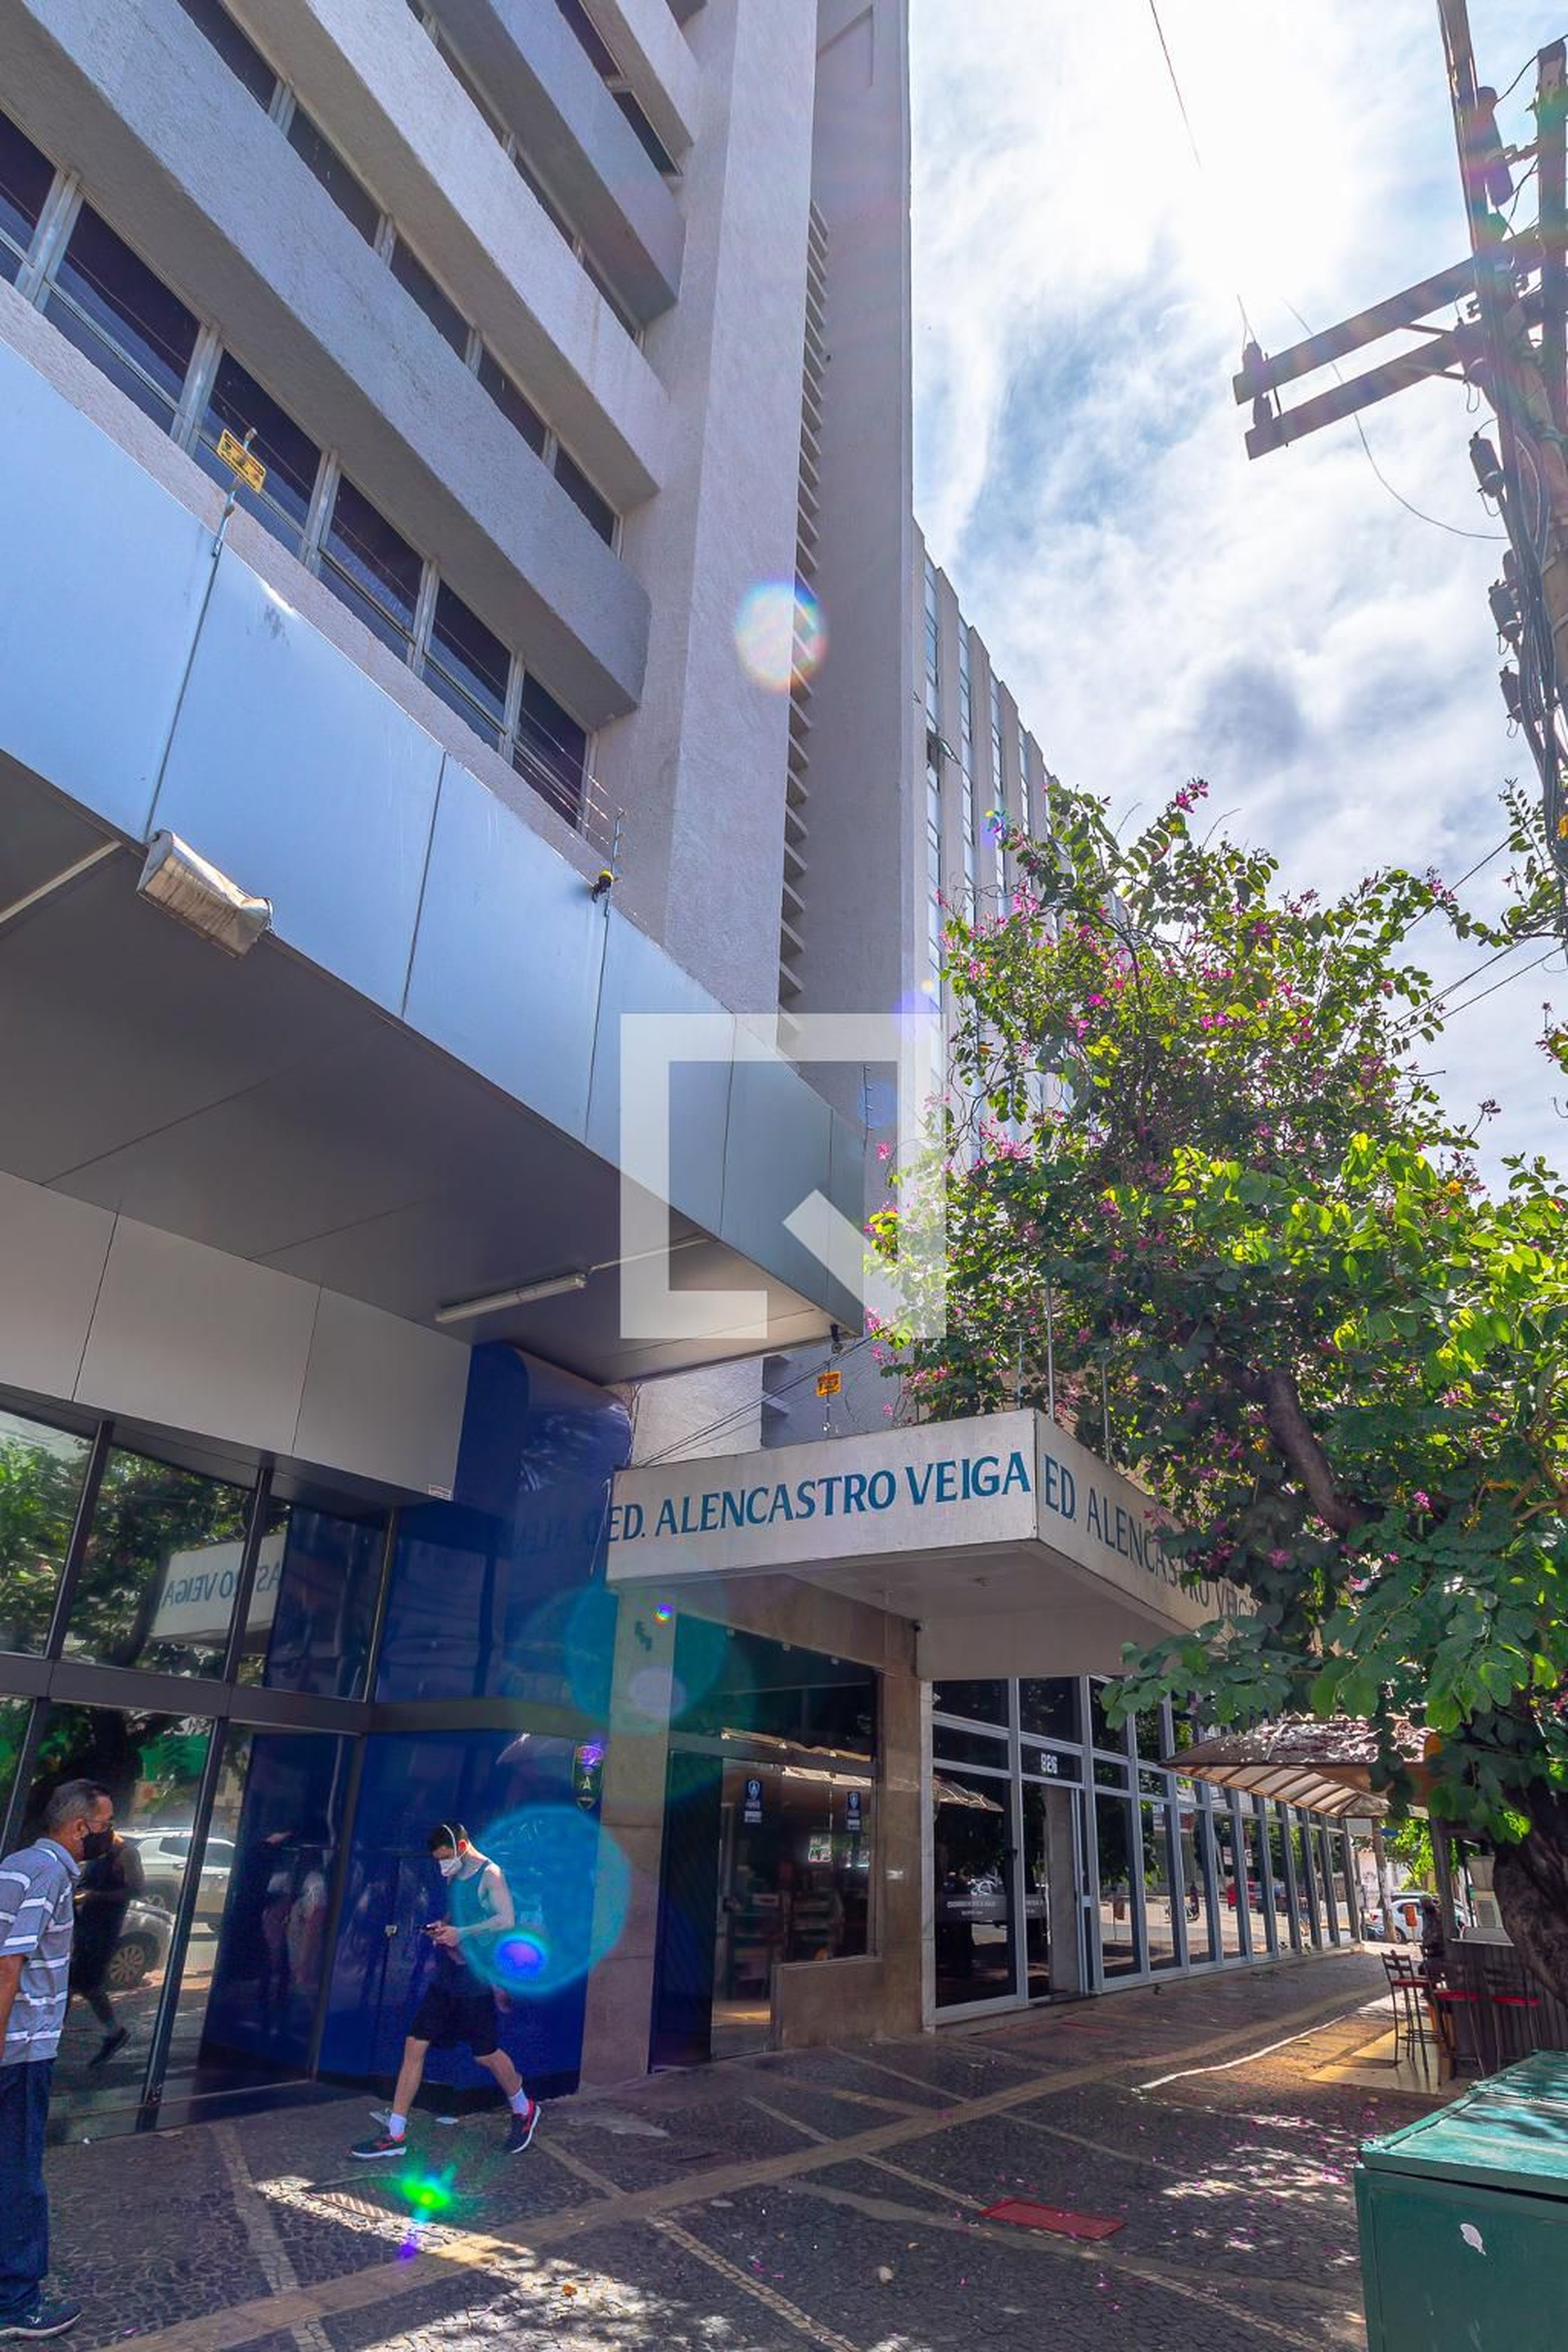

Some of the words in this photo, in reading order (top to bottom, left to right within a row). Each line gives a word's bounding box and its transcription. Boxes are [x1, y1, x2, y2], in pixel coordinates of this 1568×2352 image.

[655, 1470, 896, 1537] ALENCASTRO
[905, 1451, 1031, 1506] VEIGA
[1043, 1454, 1077, 1523] ED.
